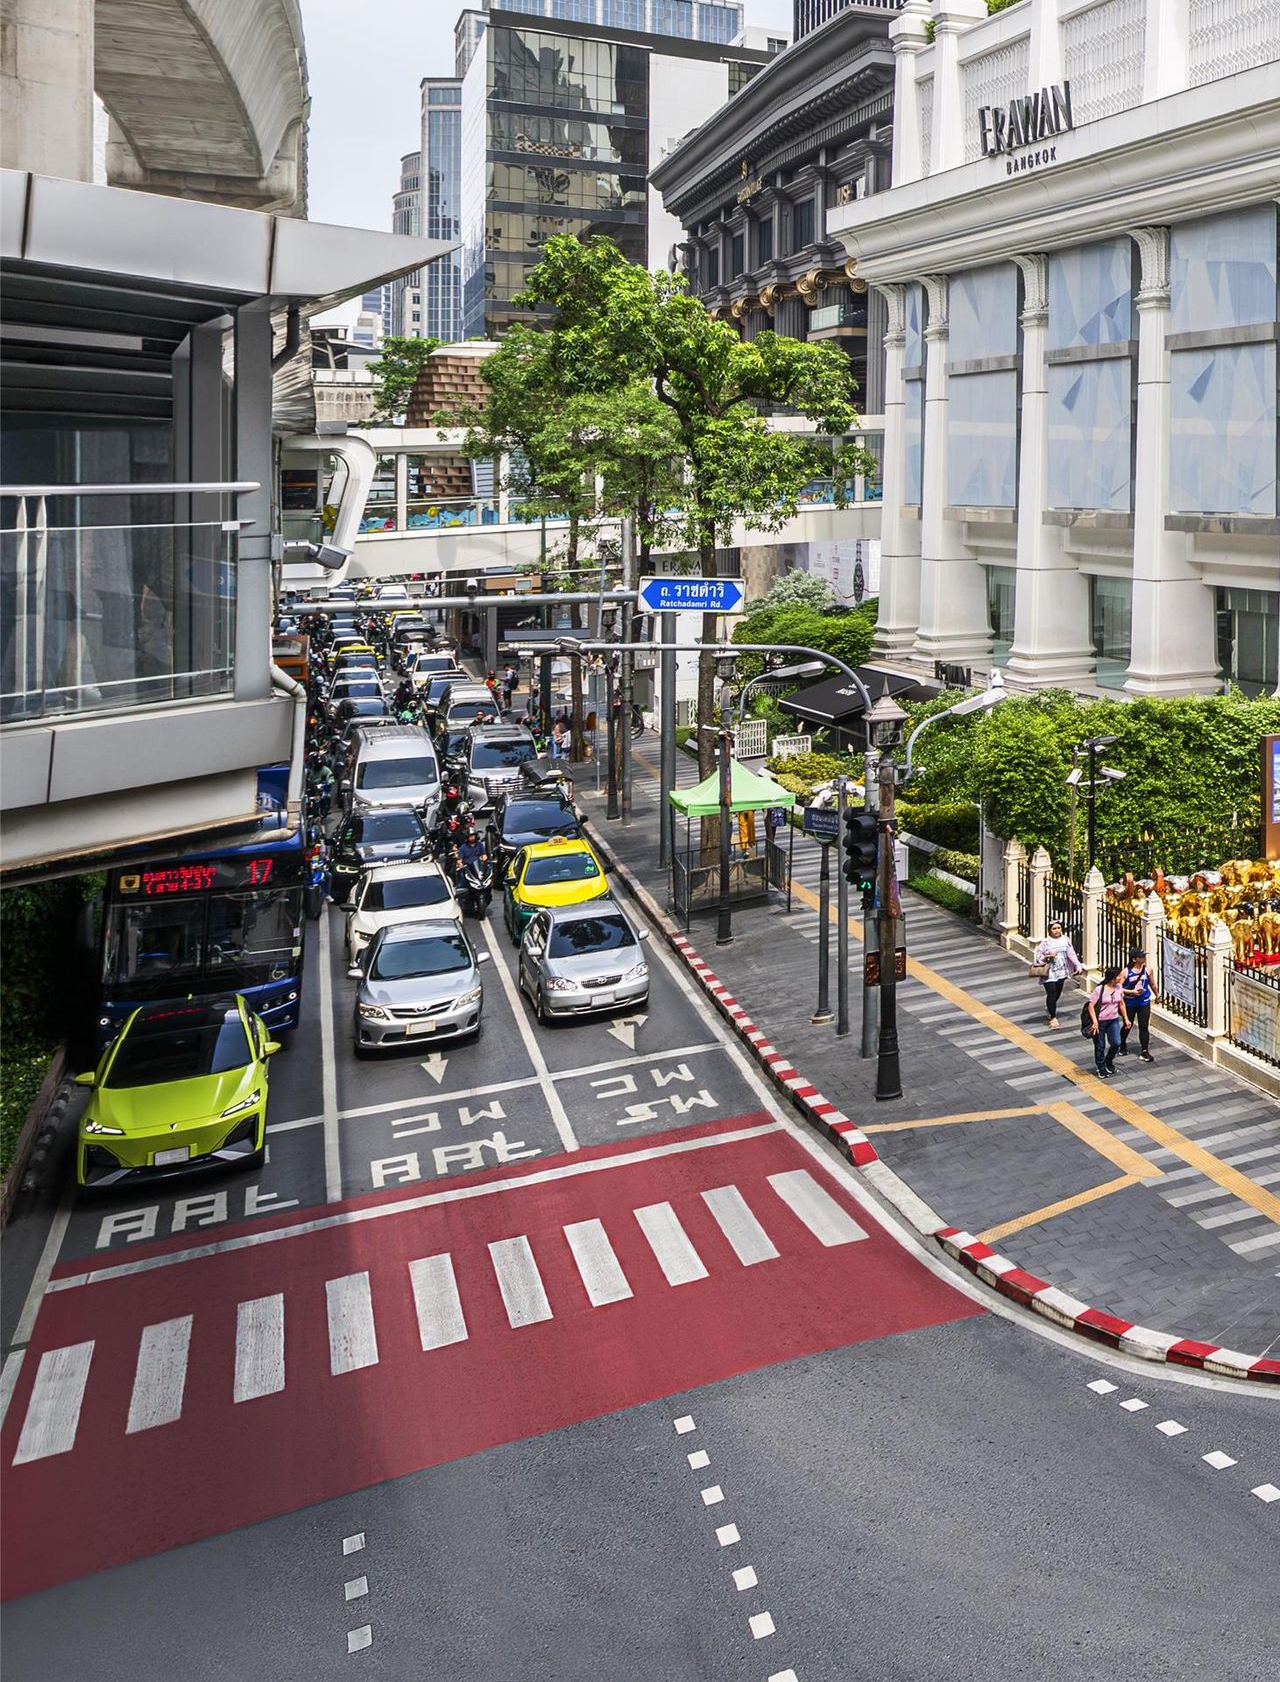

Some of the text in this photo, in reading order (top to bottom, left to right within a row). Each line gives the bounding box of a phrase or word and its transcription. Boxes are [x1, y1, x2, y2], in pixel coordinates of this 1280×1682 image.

[977, 80, 1074, 156] ERAWAN
[1006, 146, 1057, 175] BANGKOK
[660, 582, 724, 597] ถ. ราชดำริ
[660, 600, 723, 608] Ratchadamri Rd.
[249, 859, 272, 885] 17
